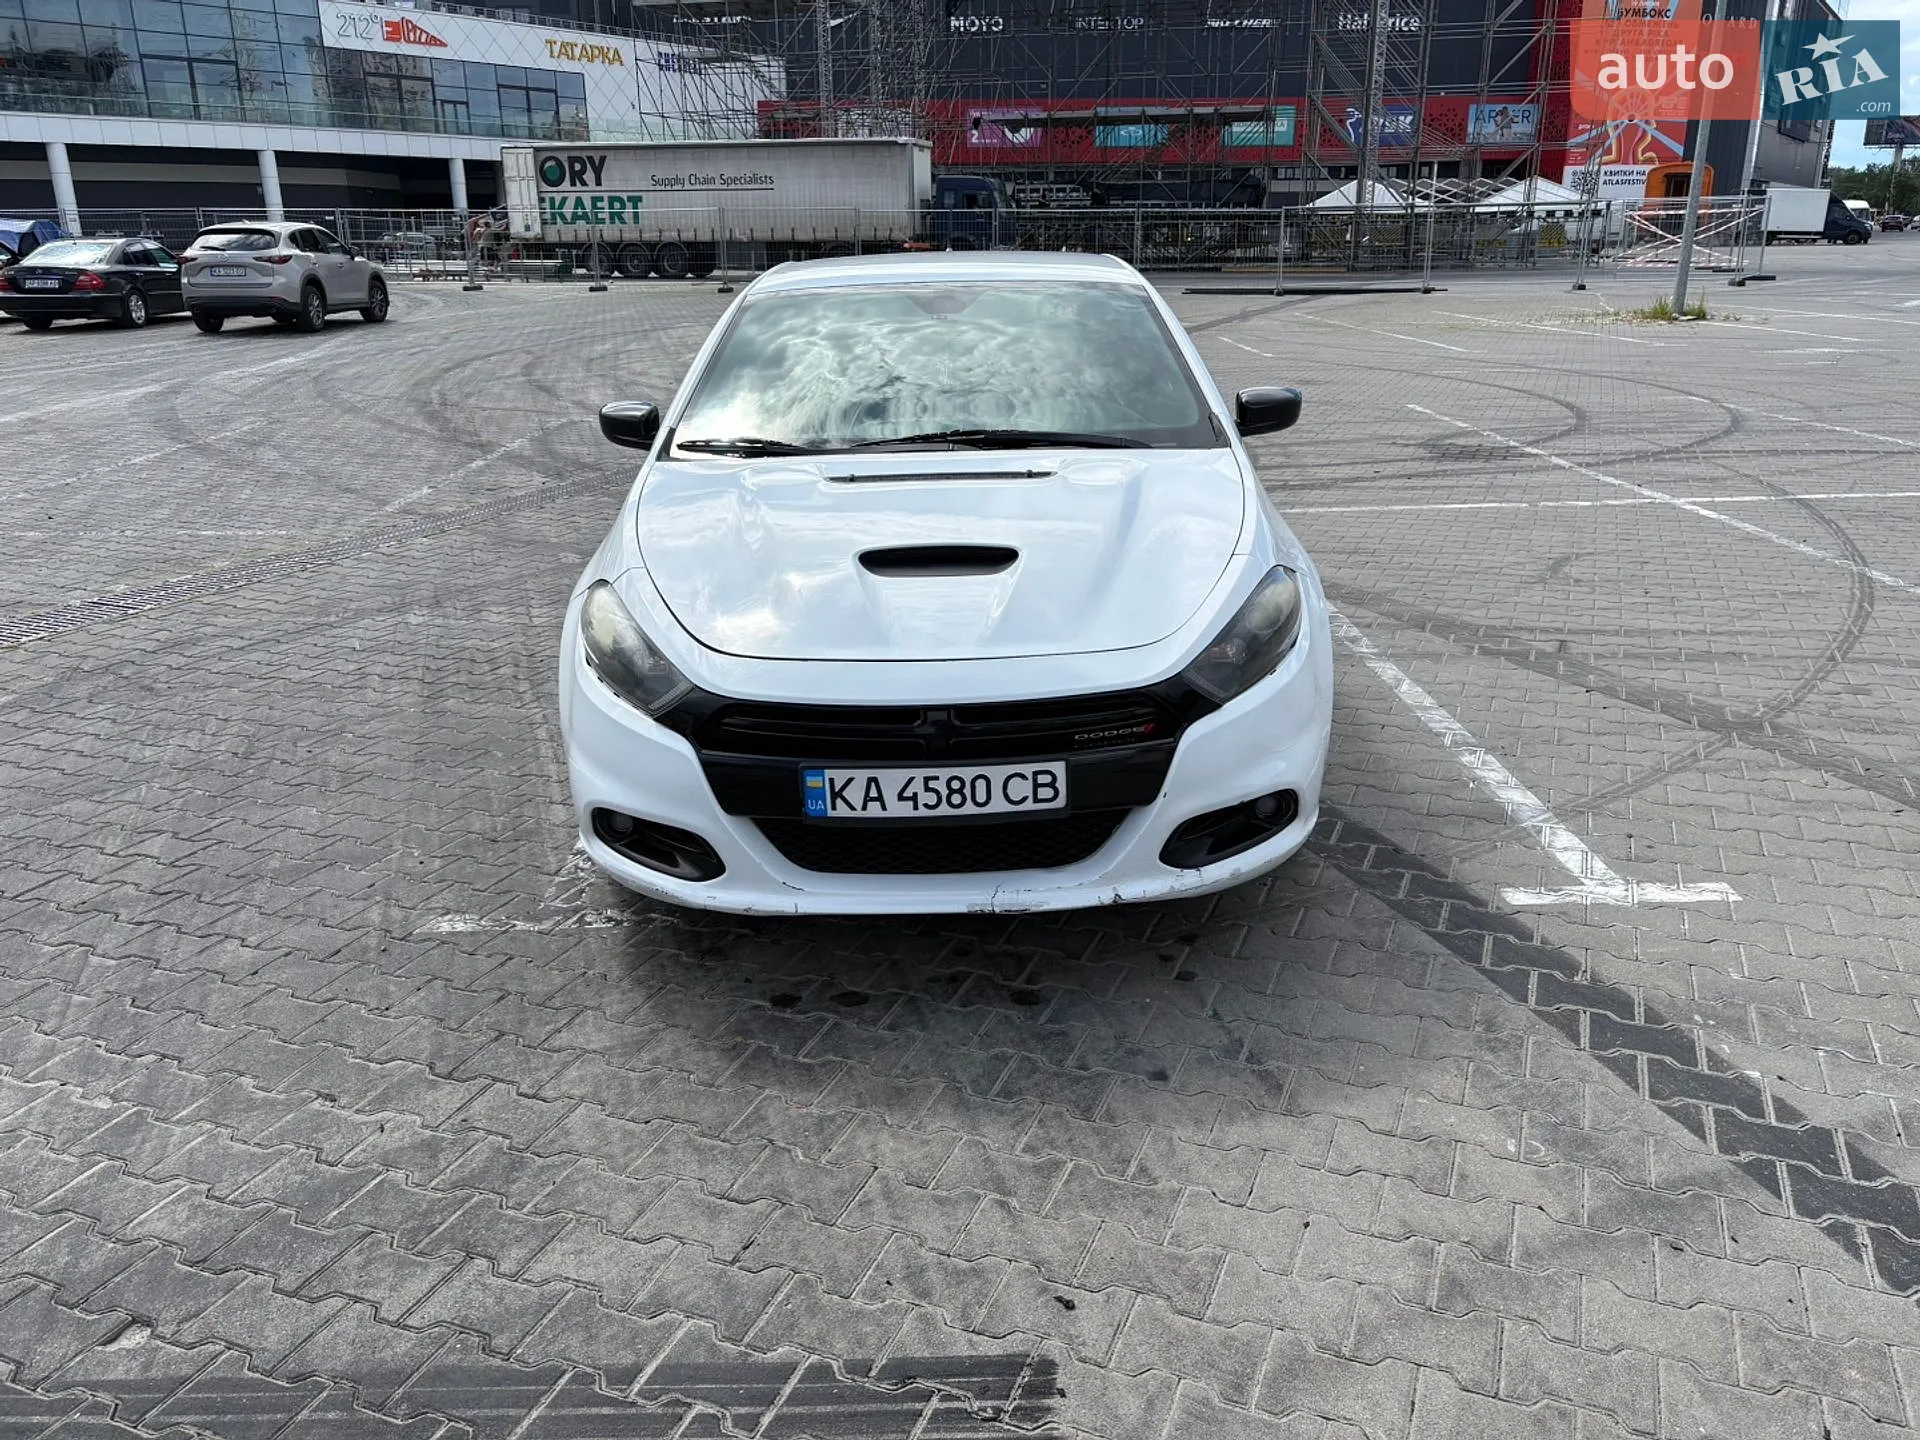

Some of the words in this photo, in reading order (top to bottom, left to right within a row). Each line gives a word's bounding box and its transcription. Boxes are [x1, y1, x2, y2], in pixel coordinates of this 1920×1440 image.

[950, 16, 1004, 32] MOYO
[545, 39, 625, 67] ТАТАРКА
[1474, 109, 1532, 125] ARER
[539, 155, 608, 188] ORY
[1603, 169, 1635, 177] КВИТКИ
[1636, 169, 1647, 177] НА
[651, 173, 684, 190] Supply
[688, 172, 717, 187] Chain
[720, 171, 775, 188] Specialists
[1074, 726, 1145, 741] DODGE
[829, 777, 889, 812] KA
[897, 774, 993, 811] 4580
[1002, 769, 1062, 807] CB
[808, 801, 825, 812] UA
